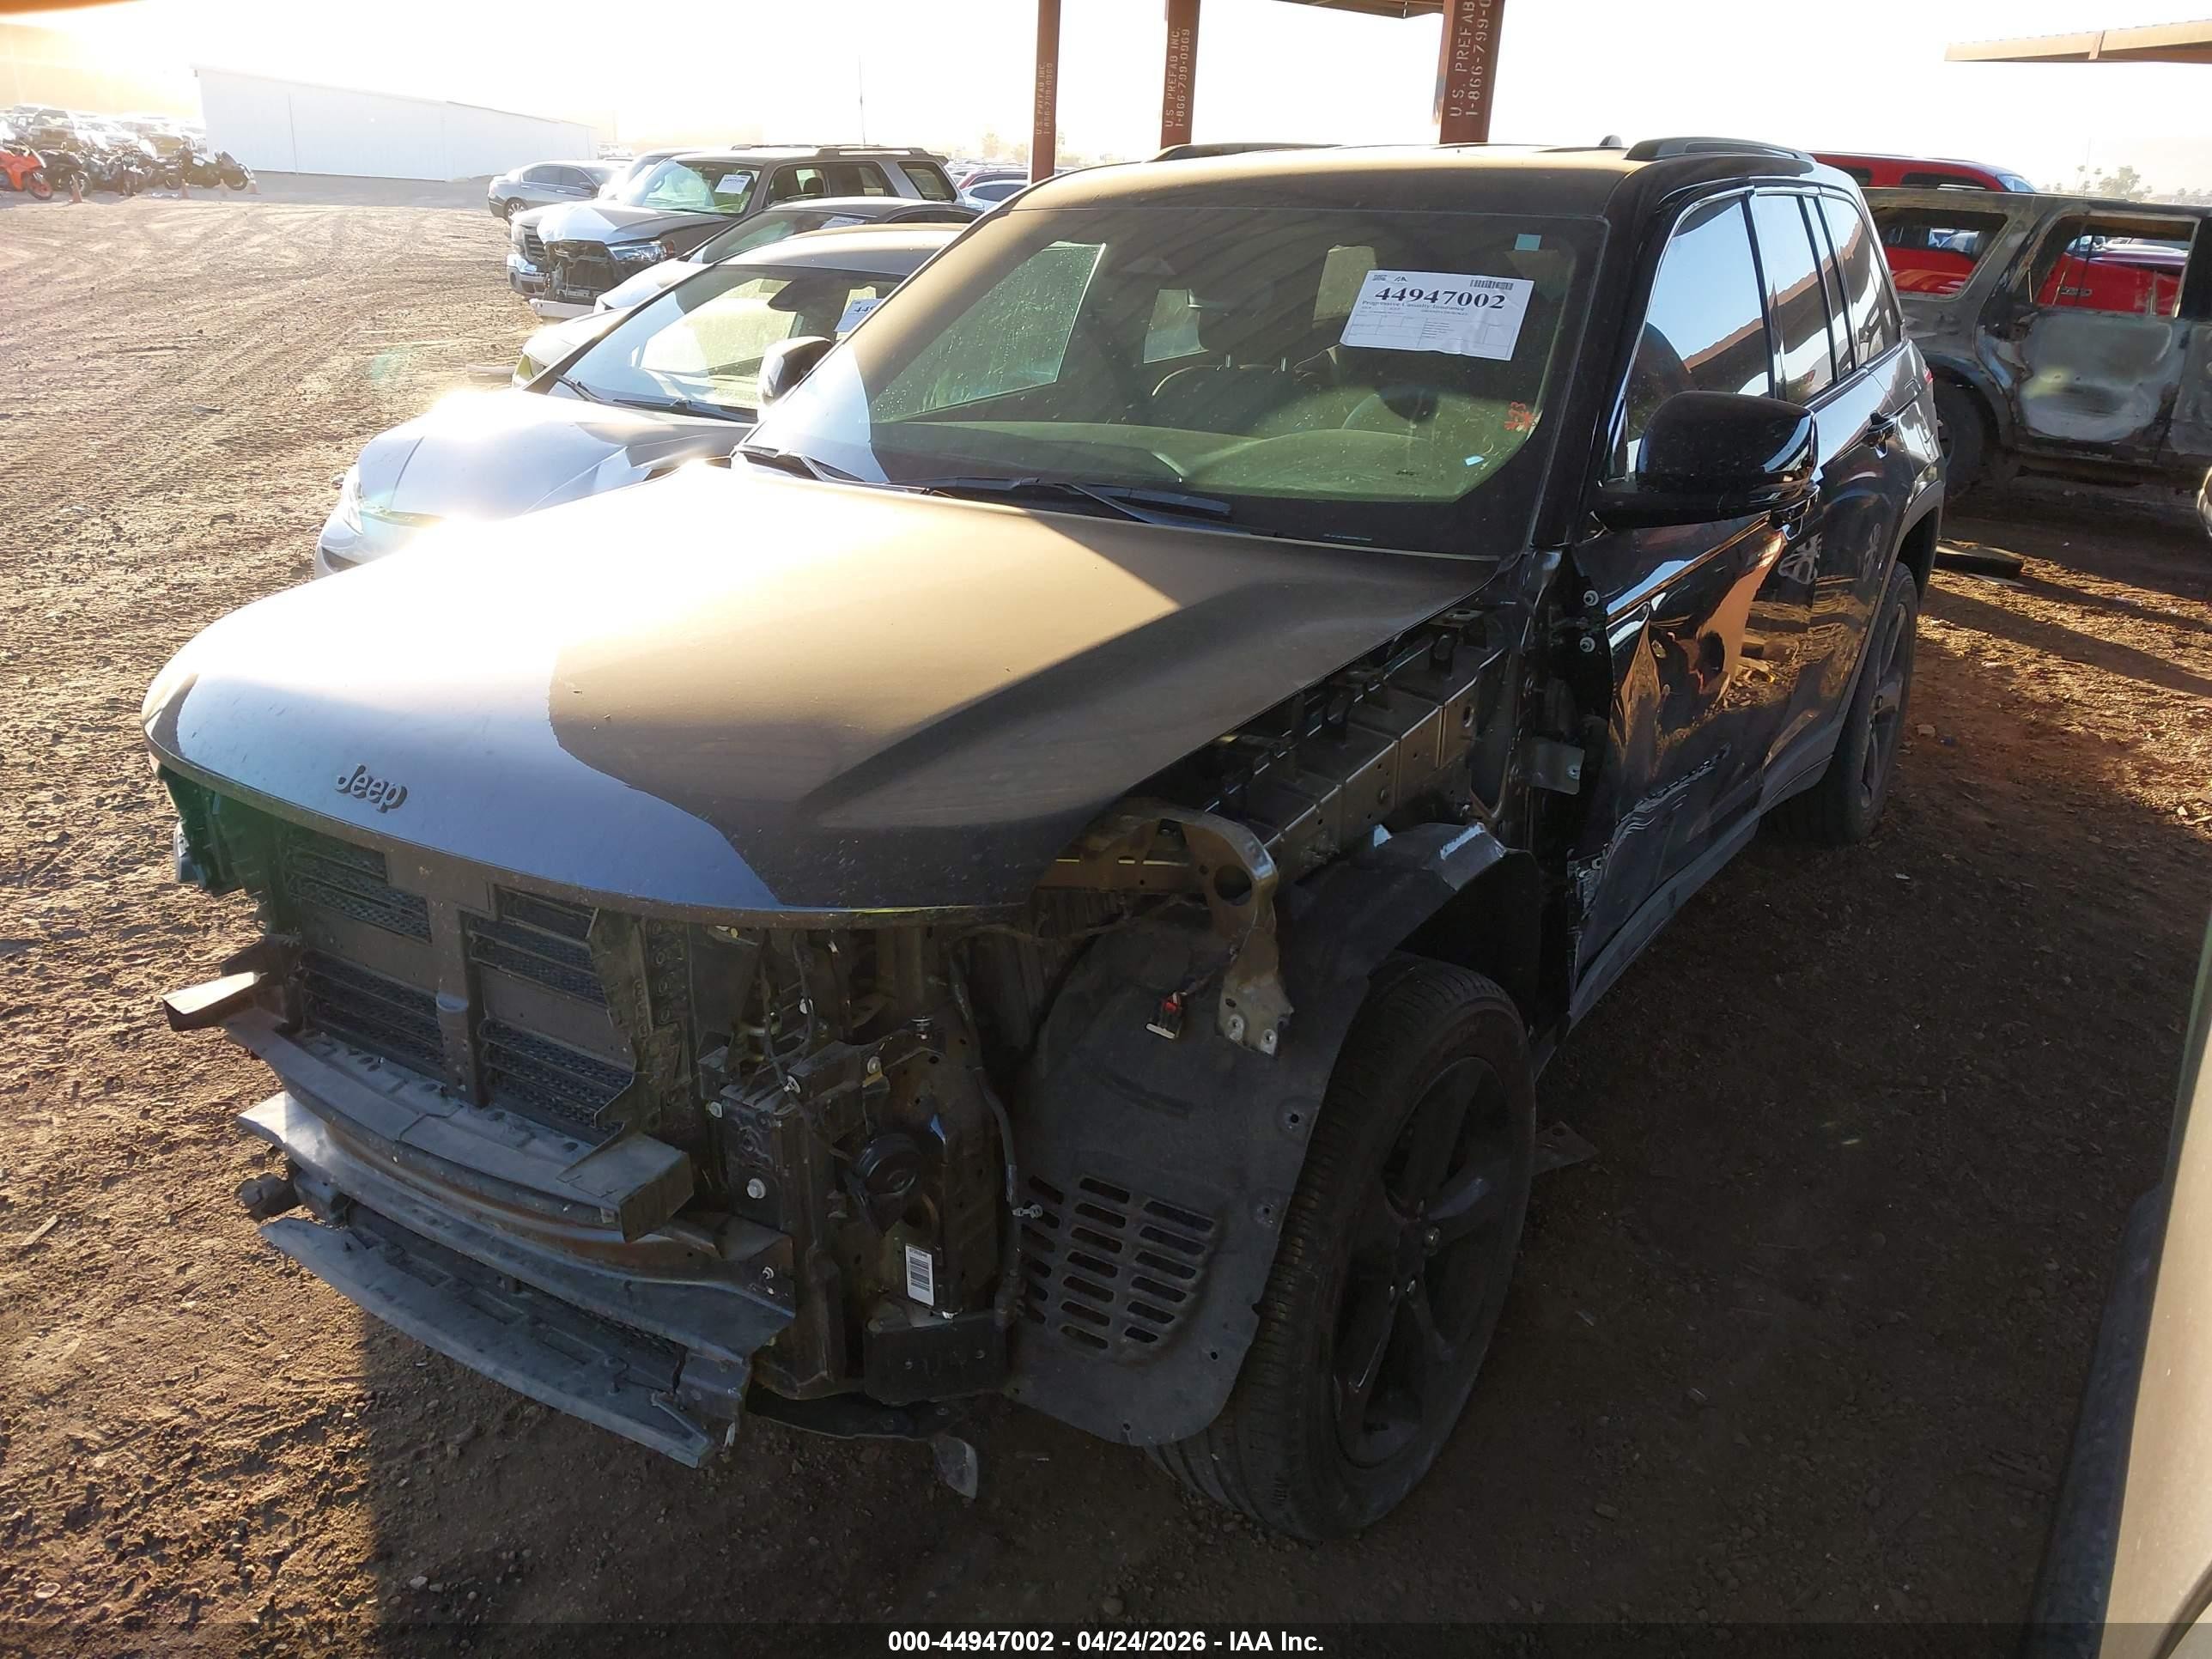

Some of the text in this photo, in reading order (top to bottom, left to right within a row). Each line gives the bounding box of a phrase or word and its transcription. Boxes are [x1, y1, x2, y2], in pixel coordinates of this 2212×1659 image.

[1170, 27, 1181, 49] INC.
[1455, 1, 1475, 72] PREFAB
[1167, 55, 1179, 100] PREFAB
[1176, 28, 1190, 127] 1-866-799-0969
[1375, 286, 1506, 310] 44947002
[335, 763, 408, 814] Jeep
